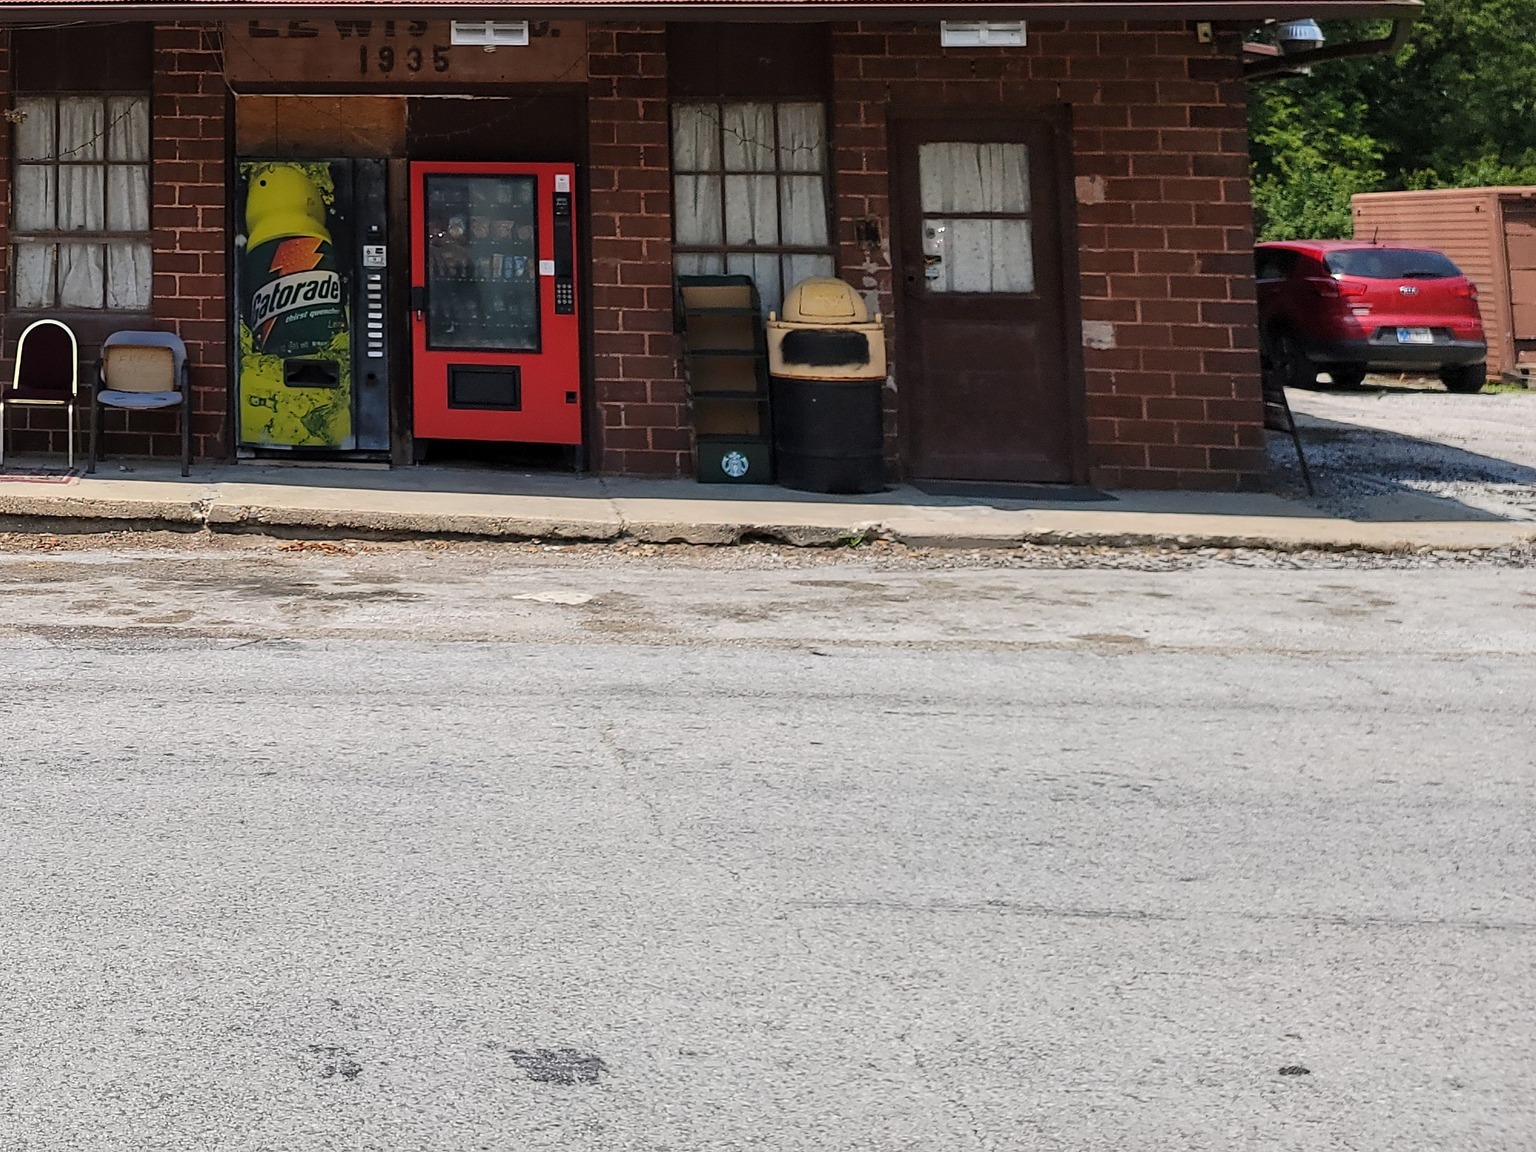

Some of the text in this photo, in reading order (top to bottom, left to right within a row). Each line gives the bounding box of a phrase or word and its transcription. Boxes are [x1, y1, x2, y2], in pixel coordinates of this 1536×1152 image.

[359, 45, 450, 74] 1935
[252, 274, 339, 325] Gatorade
[285, 311, 308, 323] thirst
